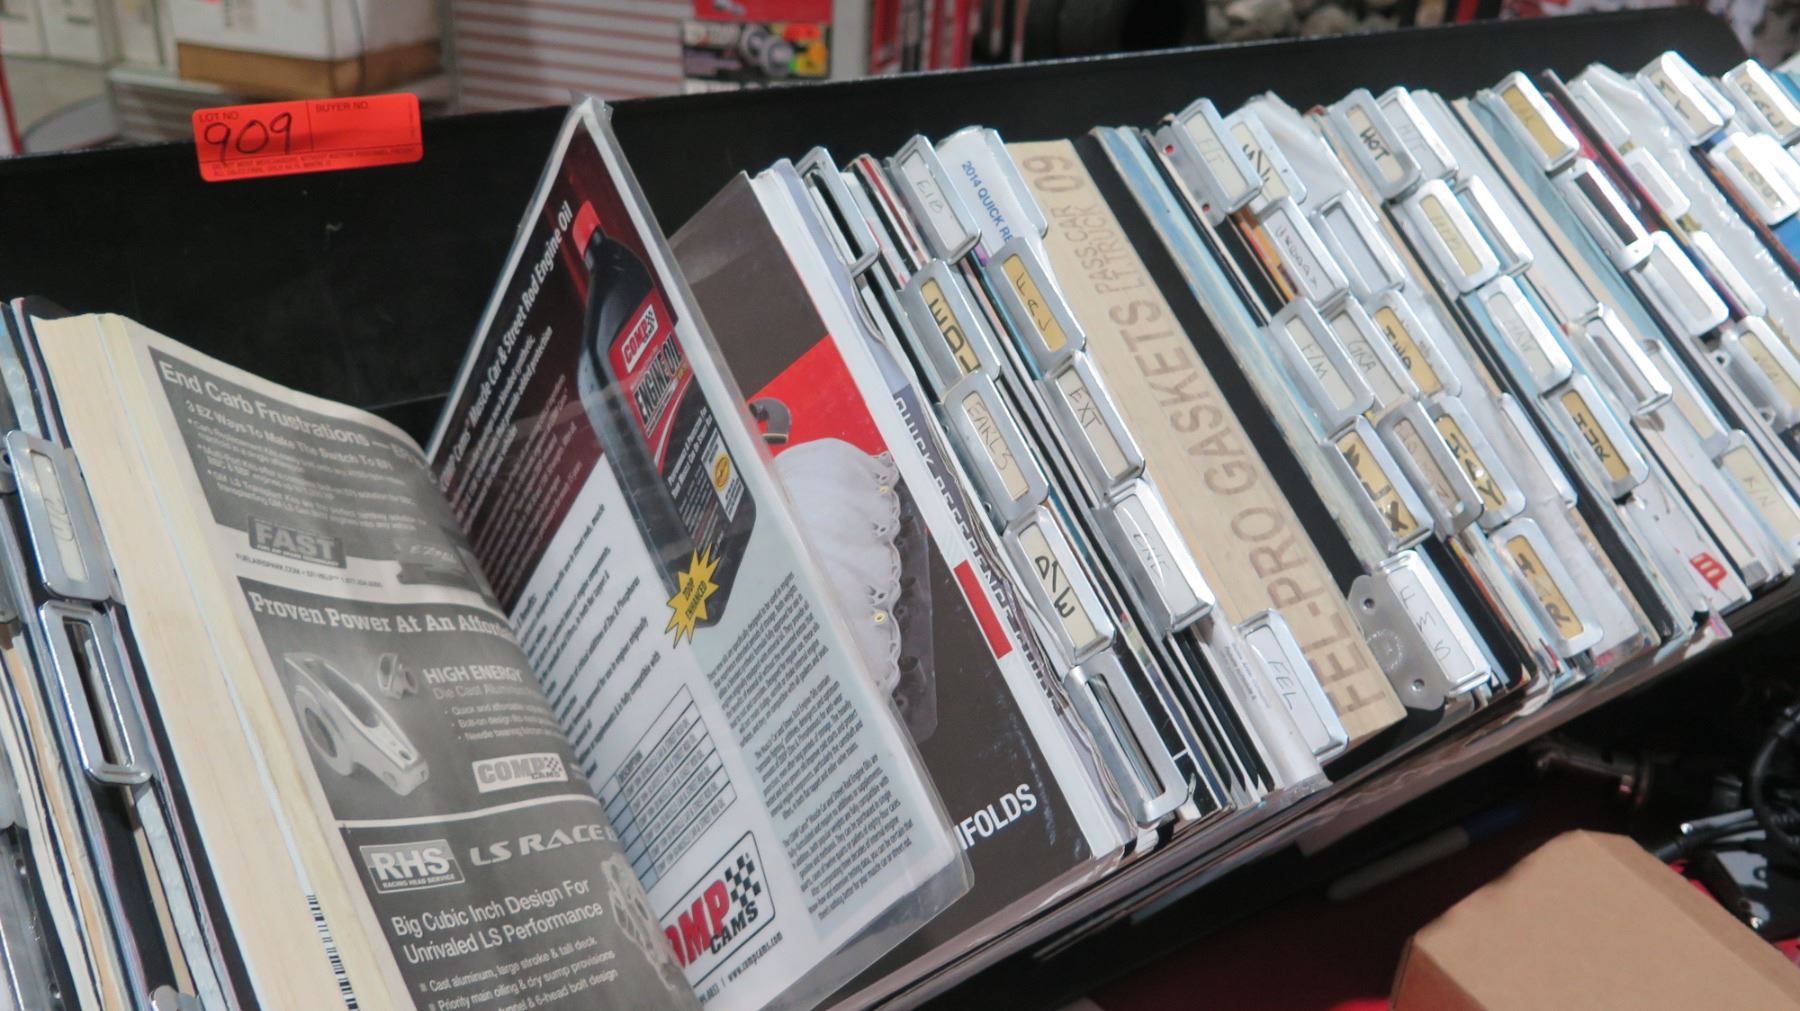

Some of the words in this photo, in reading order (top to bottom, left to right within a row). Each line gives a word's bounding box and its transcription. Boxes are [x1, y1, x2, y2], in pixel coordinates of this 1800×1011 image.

[198, 112, 219, 122] LOT
[315, 101, 352, 113] BUYER
[204, 113, 292, 166] 909
[1359, 126, 1391, 161] HOT
[962, 160, 980, 189] 2014
[978, 187, 1003, 228] QUICK
[1023, 154, 1083, 193] 09
[557, 202, 578, 232] Oil
[535, 227, 566, 279] Engine
[520, 273, 544, 312] Rod
[500, 307, 528, 353] Street
[621, 316, 651, 363] COMP
[485, 359, 503, 385] Car
[495, 347, 509, 364] &
[467, 379, 493, 425] Muscle
[631, 353, 673, 424] ENGINE
[659, 334, 683, 374] OIL
[1108, 302, 1258, 496] GASKETS
[159, 360, 202, 395] End
[205, 381, 254, 416] Carb
[256, 402, 370, 447] Frustrations
[1069, 386, 1103, 430] EXT
[196, 404, 213, 421] EZ
[214, 409, 247, 435] Ways
[247, 423, 263, 439] To
[264, 429, 296, 450] Make
[1574, 413, 1609, 460] HUR
[255, 522, 336, 560] FAST
[250, 591, 326, 626] Proven
[325, 606, 393, 633] Power
[397, 613, 424, 632] At
[427, 612, 457, 632] An
[1230, 507, 1385, 718] FEL-PRO
[1399, 587, 1451, 662] FMS
[423, 665, 470, 685] HIGH
[470, 664, 523, 682] ENERGY
[1268, 659, 1297, 711] FEL
[477, 757, 545, 784] COMP
[531, 770, 560, 780] CAMS
[370, 848, 450, 881] RHS
[470, 841, 512, 866] LS
[392, 916, 423, 938] Big
[422, 908, 469, 935] Cubic
[469, 901, 505, 923] Inch
[505, 888, 564, 914] Design
[562, 878, 589, 897] For
[710, 901, 758, 954] CAMS
[403, 934, 479, 964] Unrivaled
[479, 928, 501, 949] LS
[501, 902, 603, 943] Performance
[429, 979, 452, 992] Cast
[451, 967, 497, 988] aluminum,
[497, 962, 520, 976] large
[520, 953, 550, 969] stroke
[551, 949, 559, 959] &
[559, 943, 573, 956] tall
[589, 968, 618, 986] design
[727, 931, 783, 982] www.compcams.com
[437, 995, 470, 1011] Priority
[471, 991, 493, 1004] main
[494, 982, 519, 998] oiling
[519, 978, 527, 989] &
[527, 974, 543, 988] dry
[543, 965, 571, 982] sump
[571, 949, 616, 974] provisions
